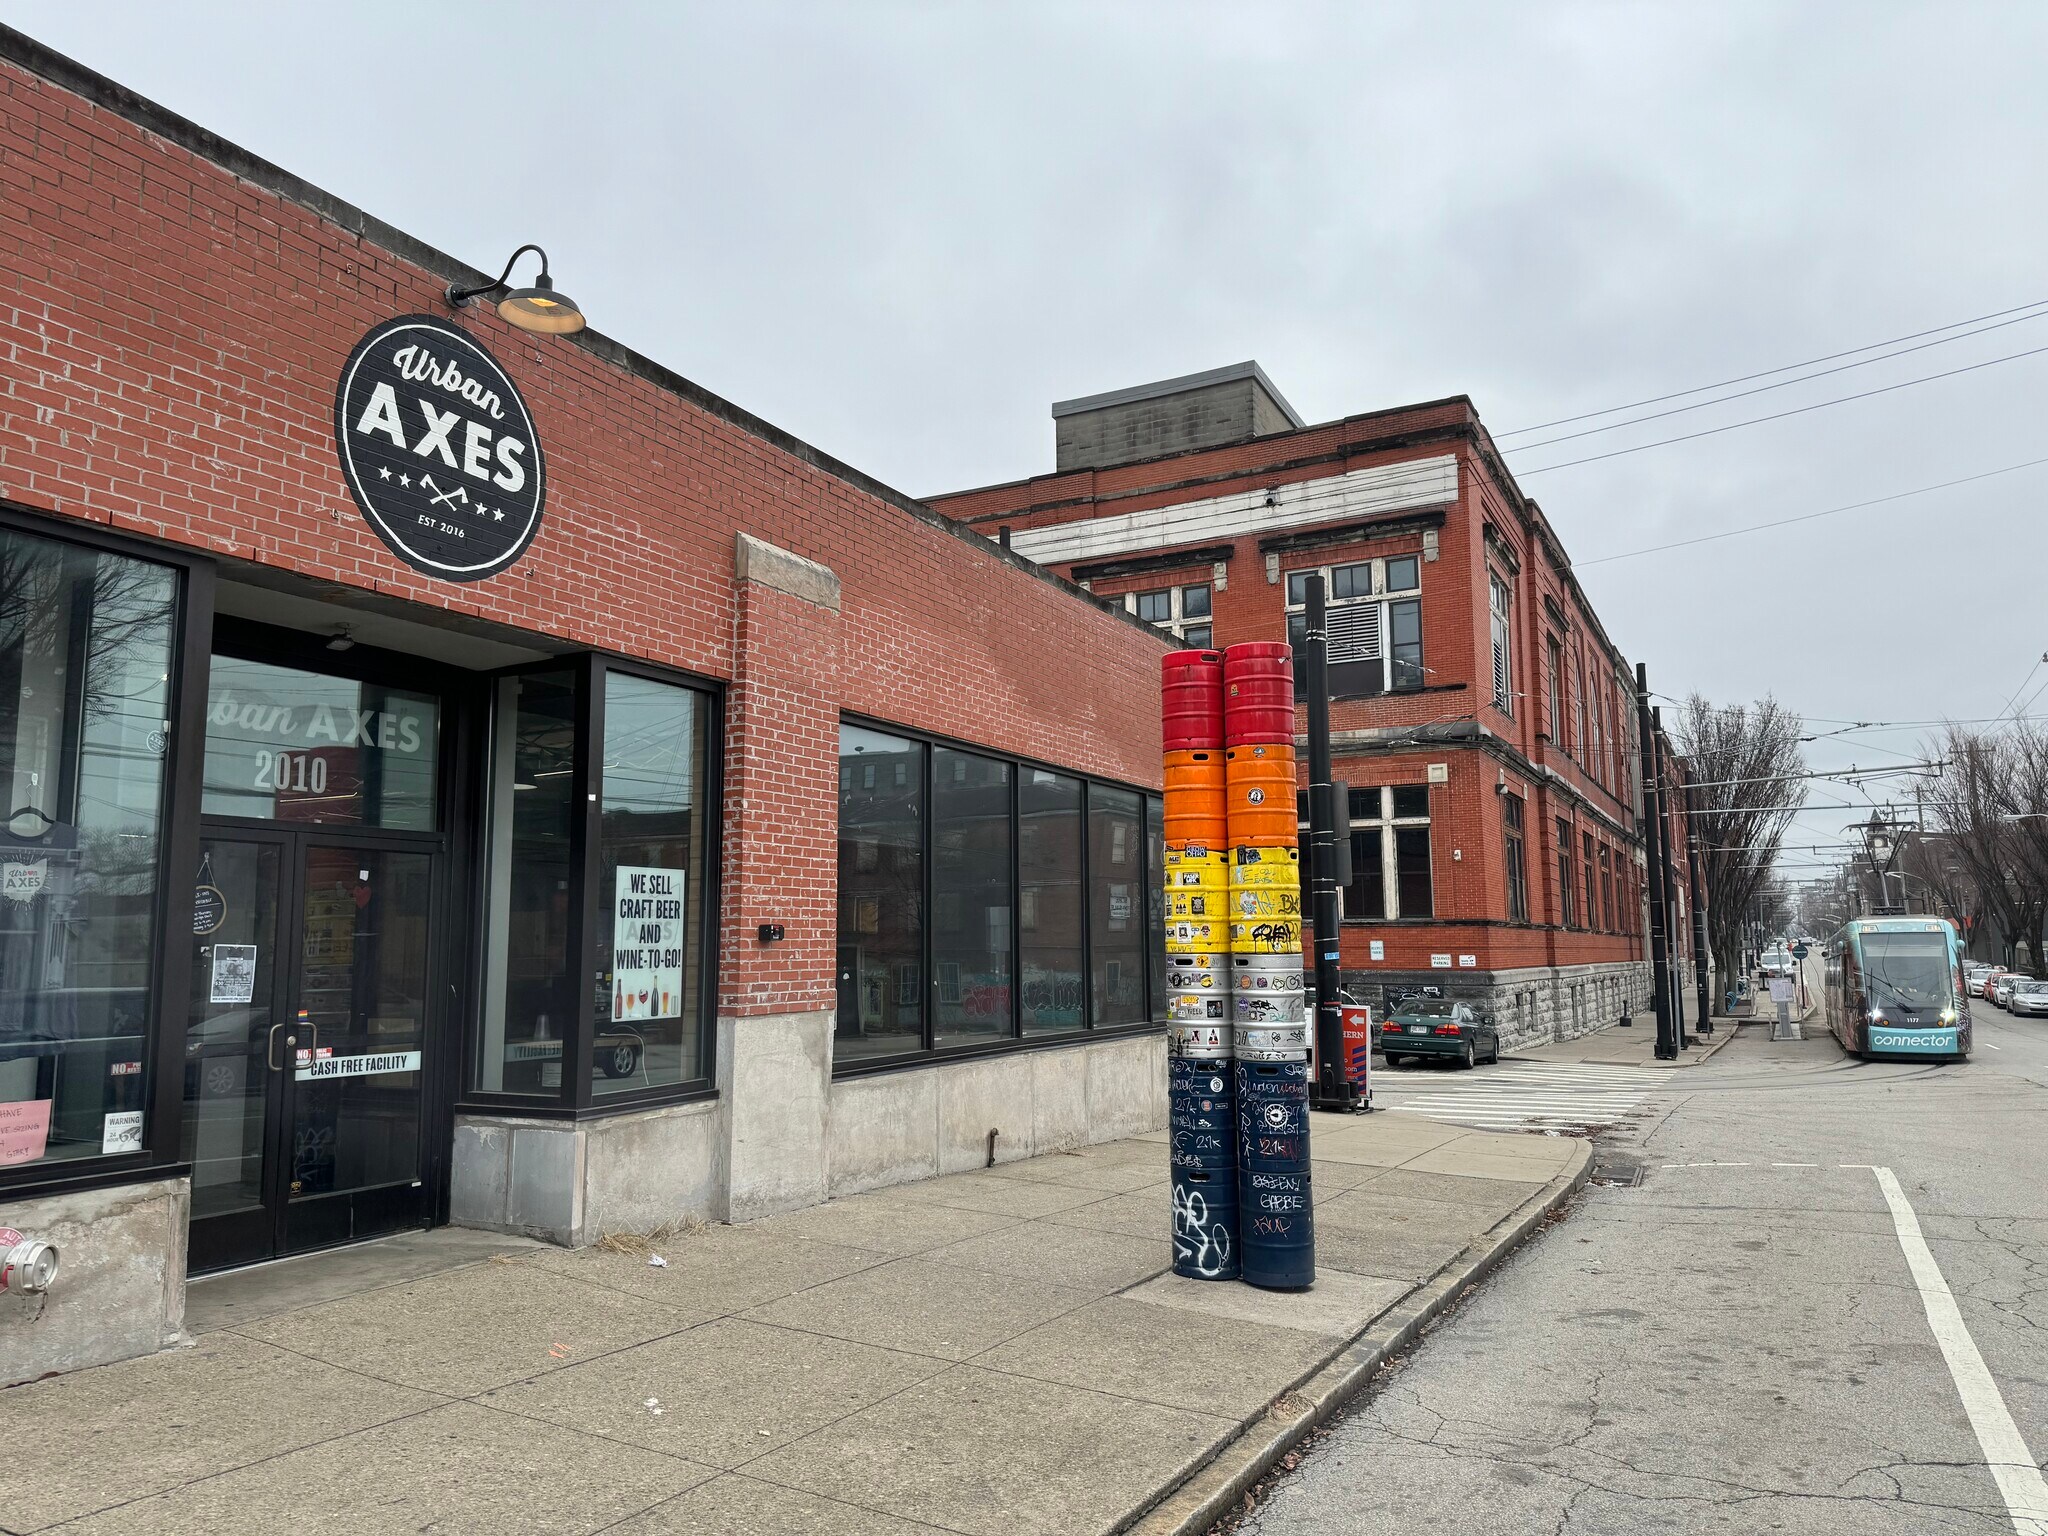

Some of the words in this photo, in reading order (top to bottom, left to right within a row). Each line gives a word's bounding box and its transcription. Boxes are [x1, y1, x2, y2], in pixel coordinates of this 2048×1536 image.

[393, 344, 505, 420] Urban
[356, 381, 525, 493] AXES
[418, 514, 435, 528] EST
[440, 522, 465, 538] 2016
[207, 689, 297, 736] ban
[305, 702, 421, 753] AXES
[254, 750, 327, 794] 2010
[6, 877, 40, 888] AXES
[631, 873, 647, 894] WE
[649, 874, 672, 895] SELL
[619, 898, 653, 919] CRAFT
[656, 899, 681, 919] BEER
[639, 924, 661, 944] AND
[616, 948, 681, 970] WINE-TO-GO!
[1874, 1034, 1953, 1046] connector
[297, 1050, 309, 1059] NO
[112, 1063, 126, 1074] NO
[310, 1060, 338, 1077] CASH
[340, 1058, 363, 1074] FREE
[366, 1054, 408, 1072] FACILITY
[109, 1116, 140, 1126] WARNING
[3, 1230, 24, 1243] AUT
